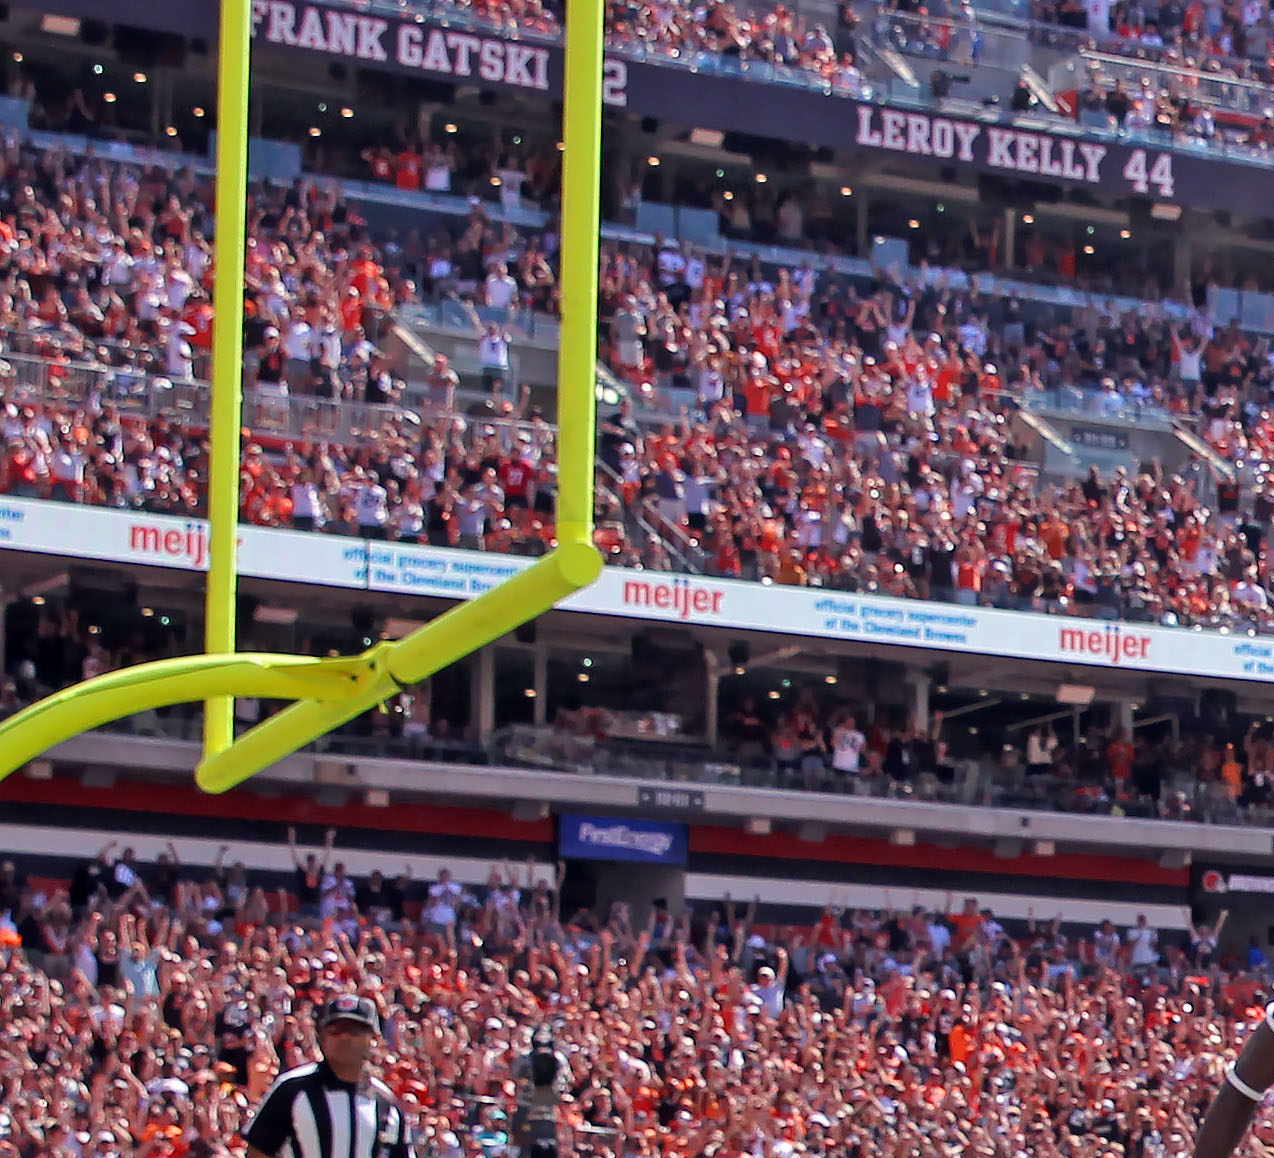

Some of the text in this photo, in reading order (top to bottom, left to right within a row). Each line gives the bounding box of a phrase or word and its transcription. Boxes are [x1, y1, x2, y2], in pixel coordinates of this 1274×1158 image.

[396, 24, 550, 90] GATSKI
[603, 58, 628, 107] 2
[856, 104, 1174, 197] LEROY KELLY 44
[131, 523, 243, 566] meij
[624, 579, 724, 621] meijer
[1061, 625, 1152, 662] meijer
